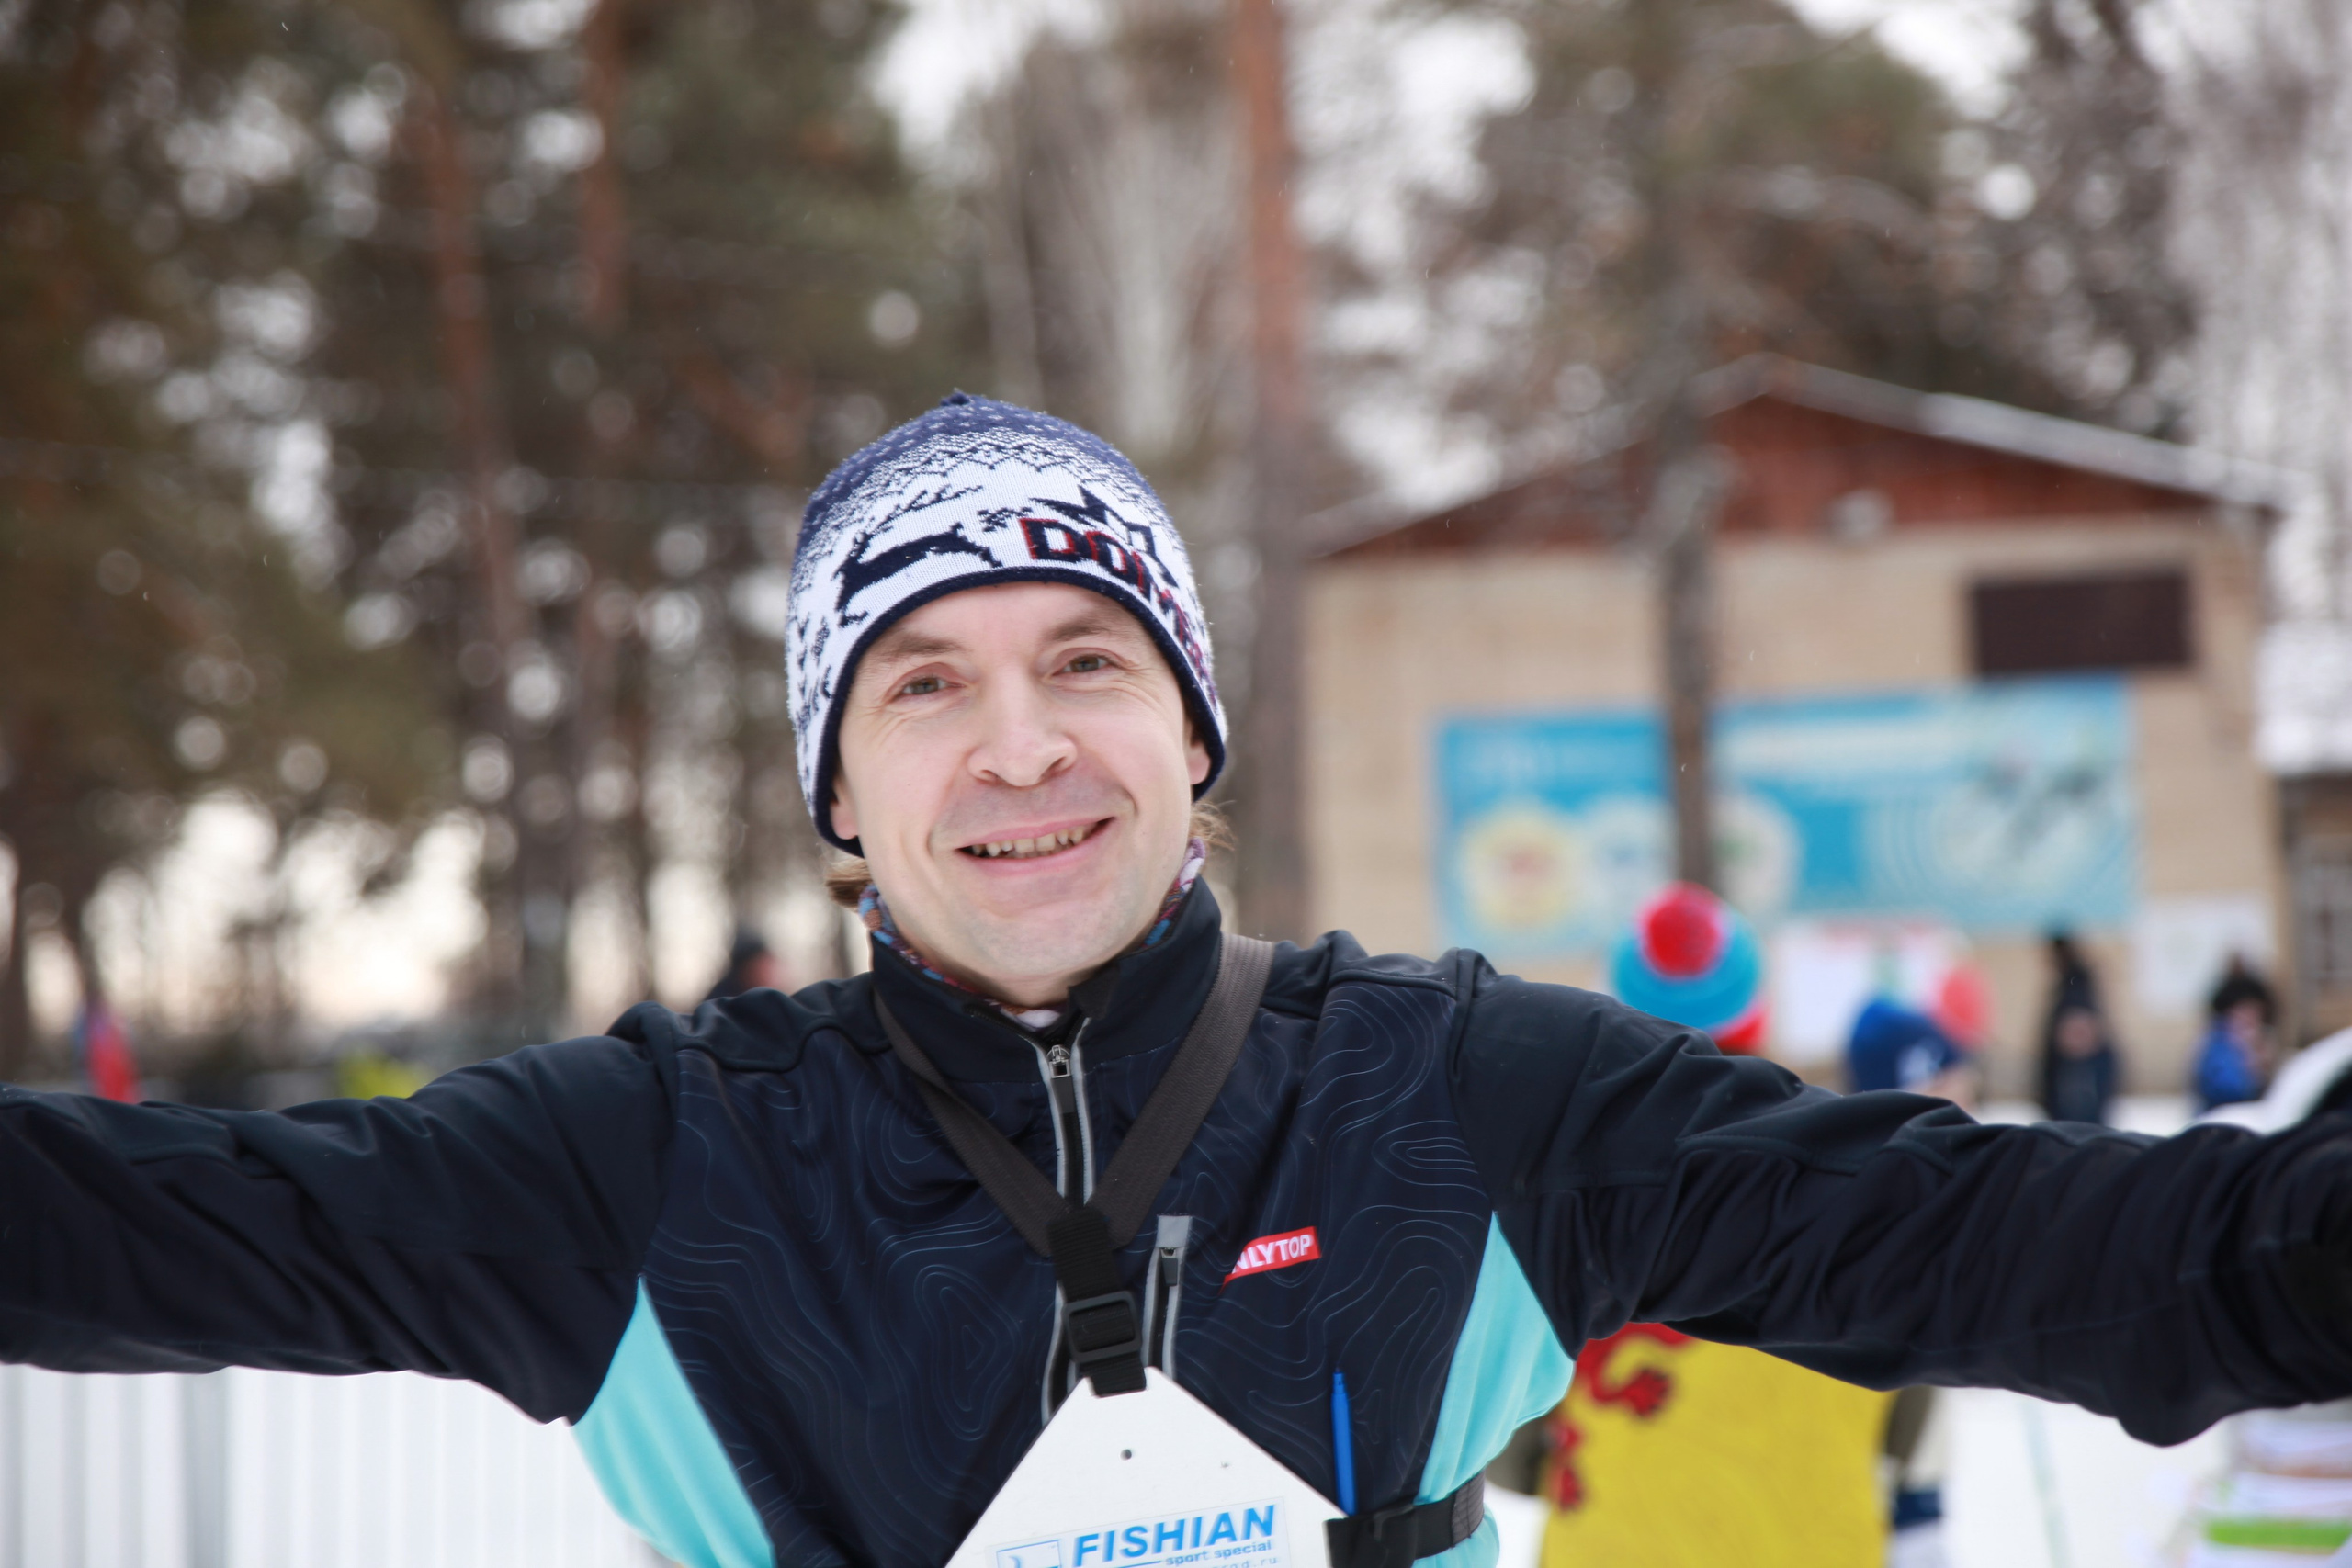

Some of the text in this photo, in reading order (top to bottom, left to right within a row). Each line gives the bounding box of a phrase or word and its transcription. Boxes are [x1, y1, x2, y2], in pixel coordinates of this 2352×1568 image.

[1231, 1235, 1313, 1274] NLYTOP
[1072, 1505, 1275, 1567] FISHIAN
[1166, 1540, 1272, 1567] sport special
